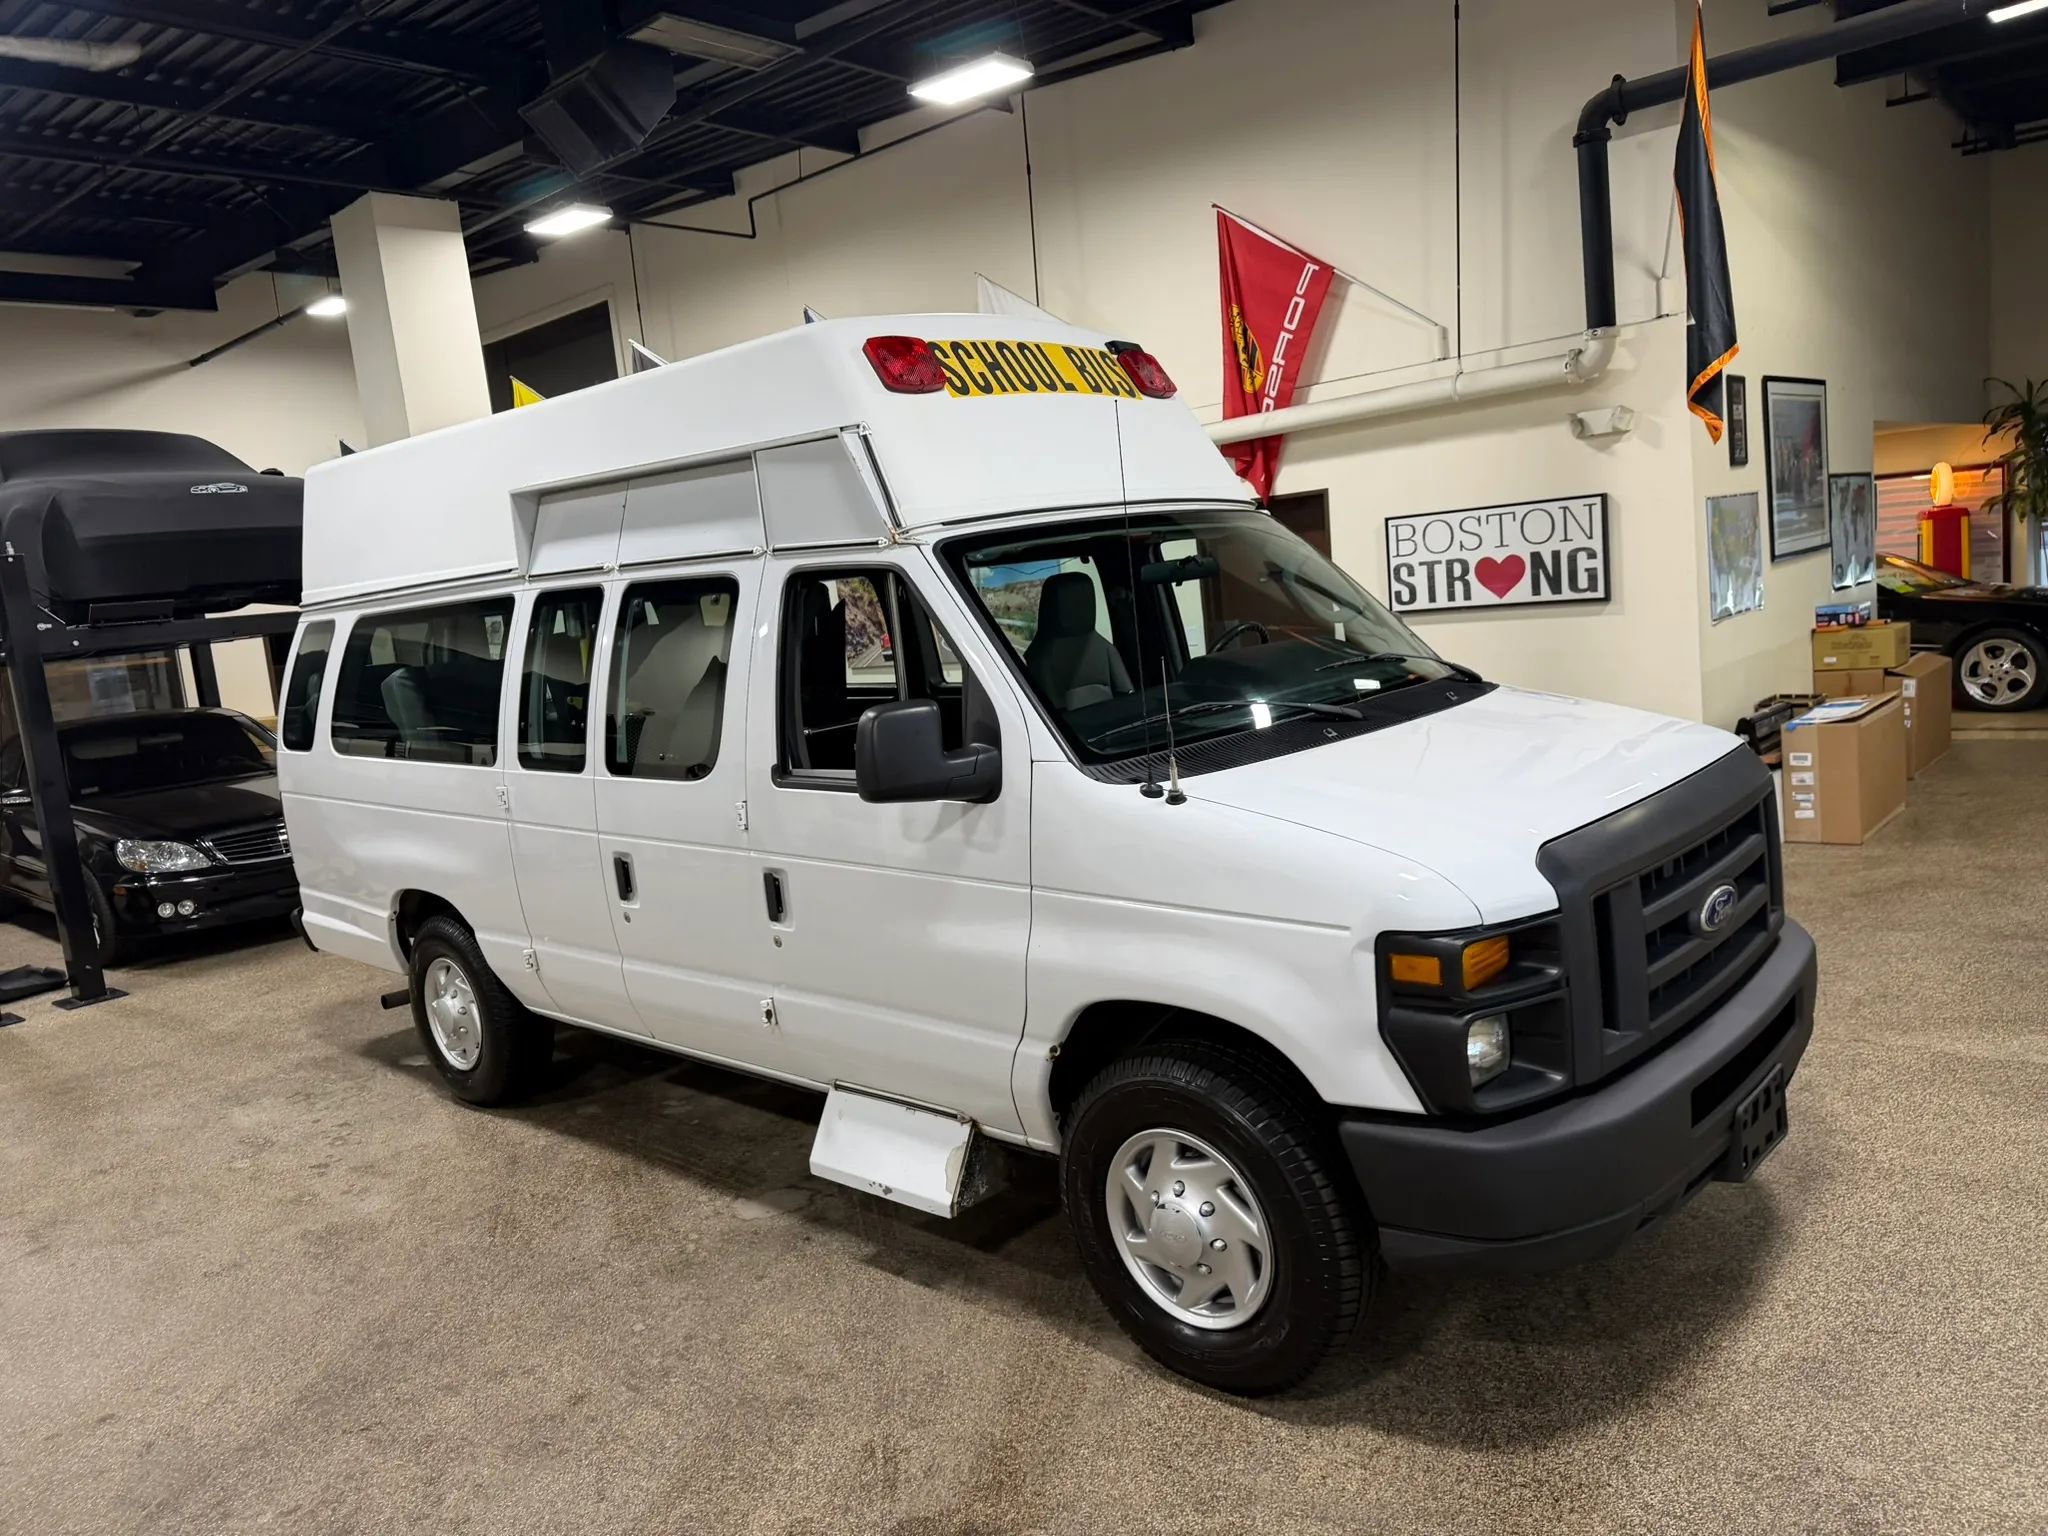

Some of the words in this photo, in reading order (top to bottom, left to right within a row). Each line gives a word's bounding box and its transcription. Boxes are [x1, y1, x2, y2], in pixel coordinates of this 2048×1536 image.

[1261, 262, 1320, 413] PORS
[927, 341, 1079, 396] SCHOOL
[1061, 346, 1137, 398] BUS
[1391, 503, 1598, 558] BOSTON
[1392, 547, 1599, 606] STRNG
